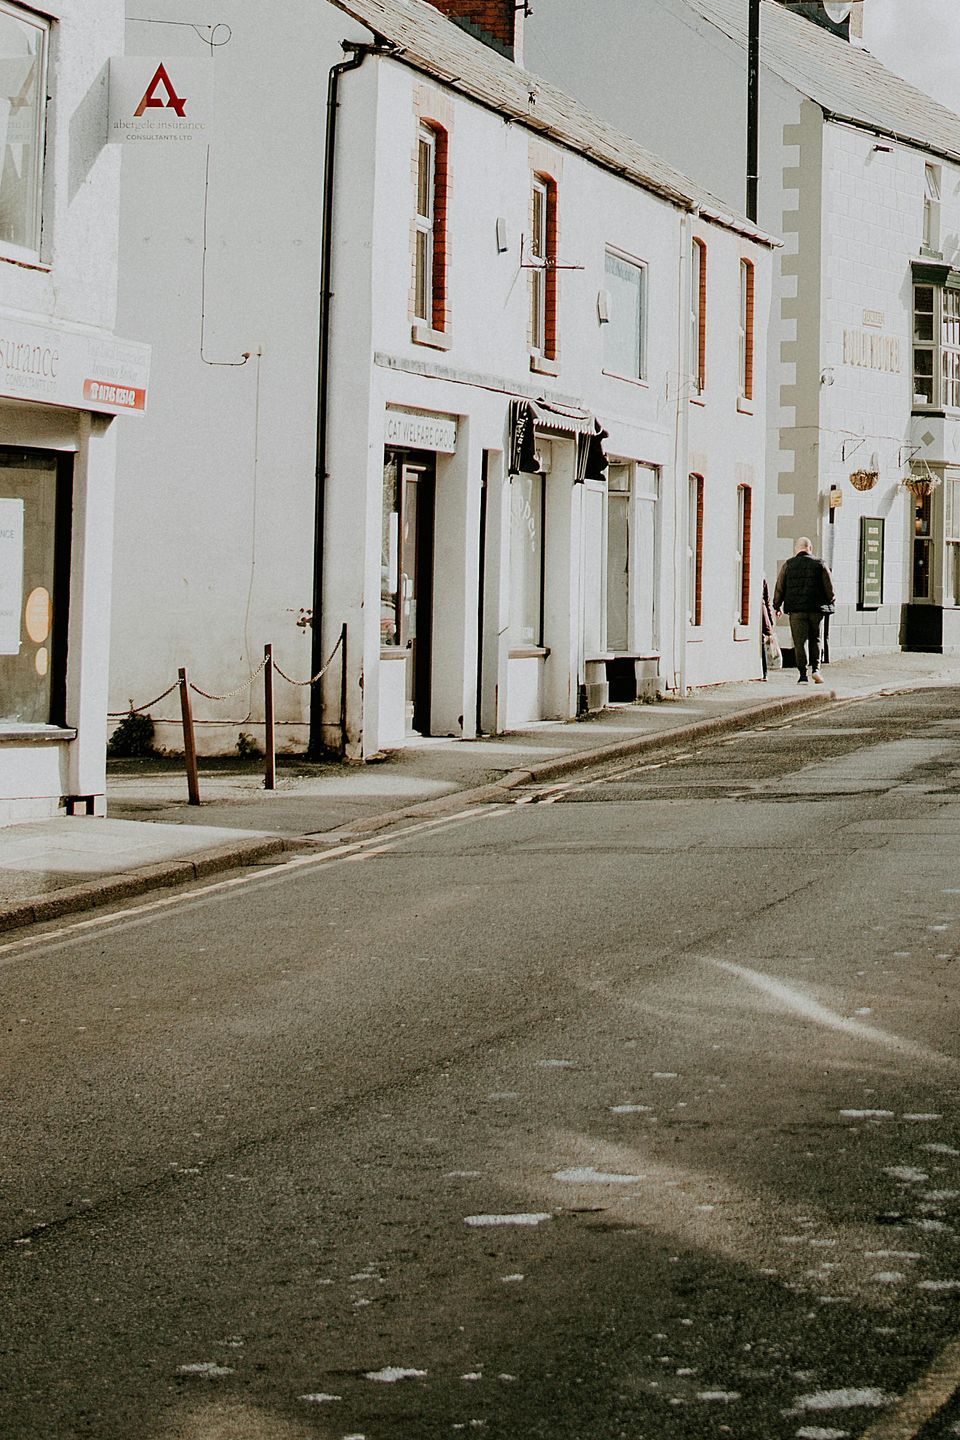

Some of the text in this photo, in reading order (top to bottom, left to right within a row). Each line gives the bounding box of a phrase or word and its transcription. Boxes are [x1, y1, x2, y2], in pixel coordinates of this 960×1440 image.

[113, 119, 206, 131] abergele insurance
[402, 422, 433, 446] WELFARE
